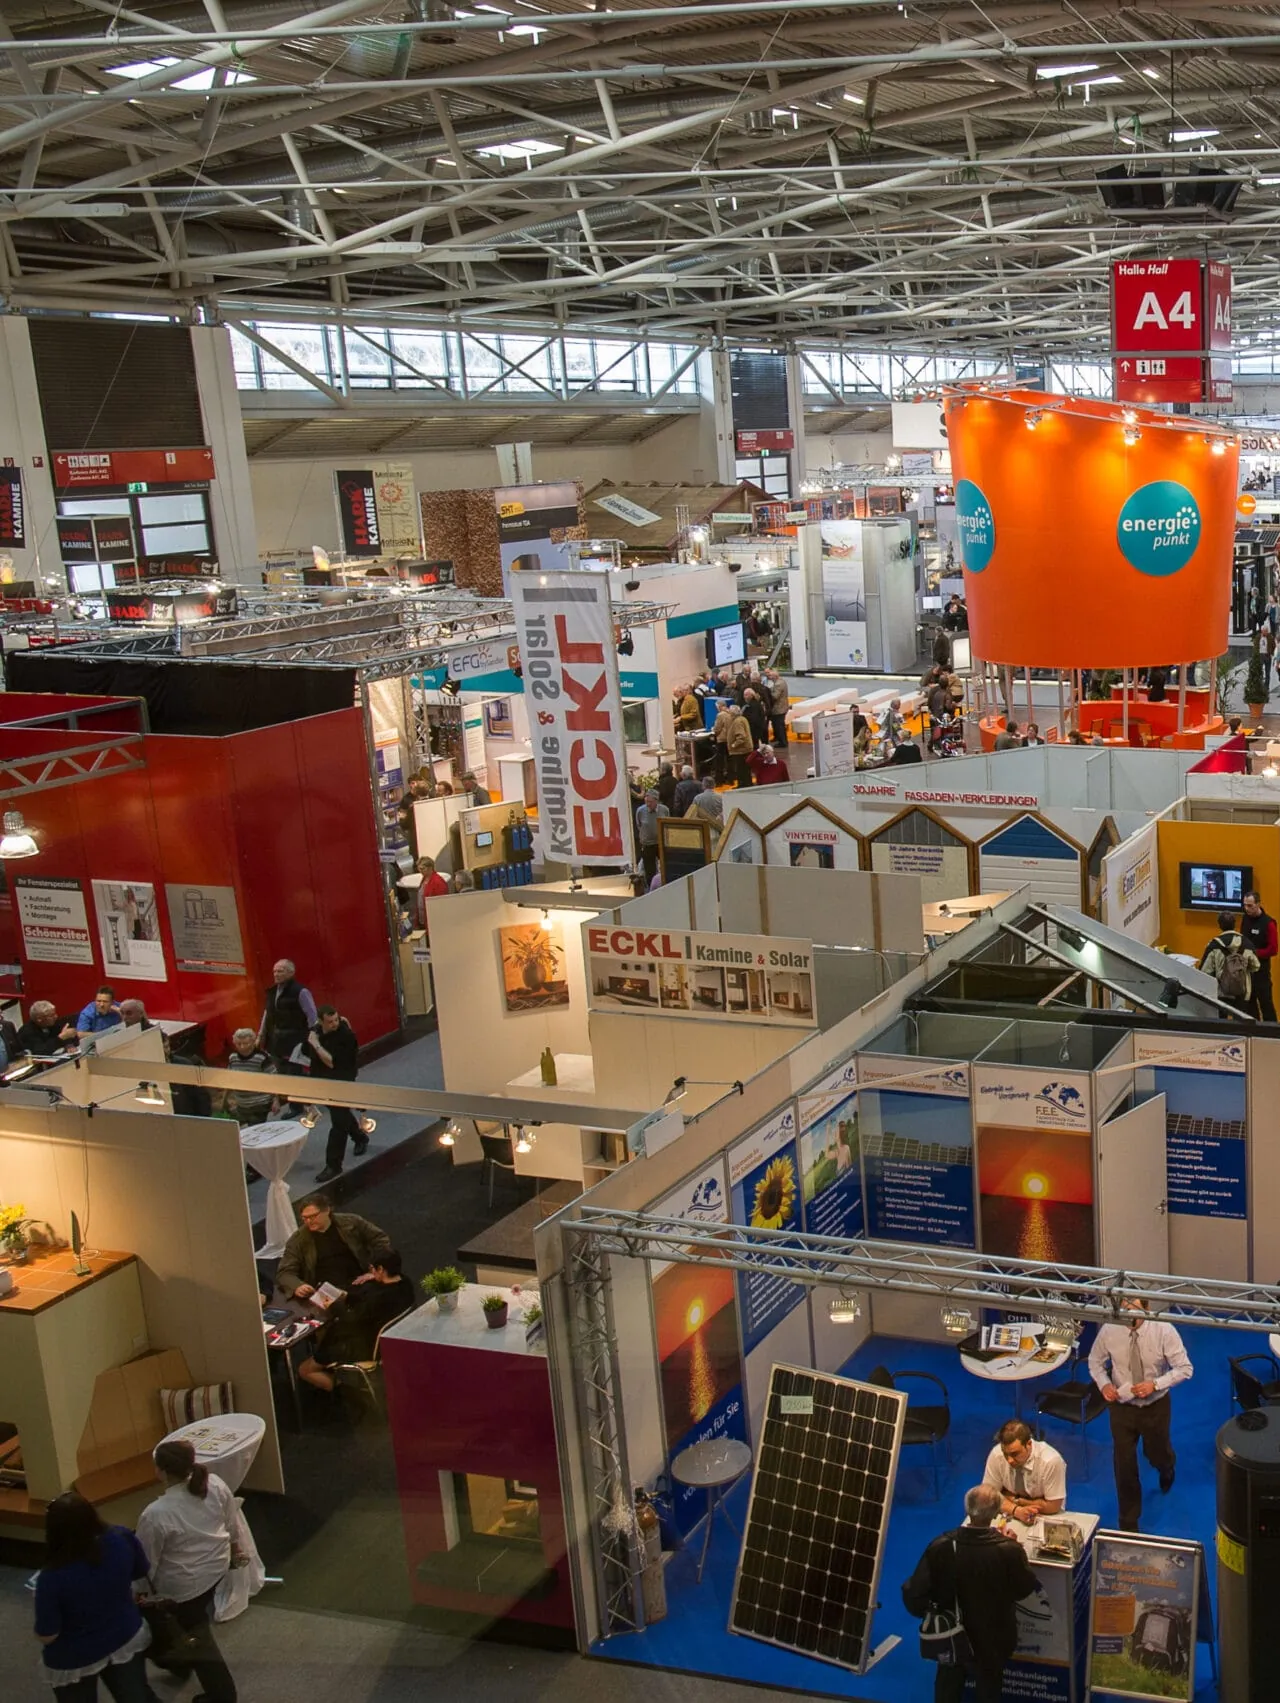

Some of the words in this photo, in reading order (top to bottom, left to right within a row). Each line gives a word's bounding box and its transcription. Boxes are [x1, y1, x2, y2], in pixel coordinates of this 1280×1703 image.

[1119, 264, 1145, 275] Halle
[1147, 264, 1169, 275] Hall
[1133, 291, 1195, 330] A4
[1214, 293, 1231, 331] A4
[13, 483, 24, 539] KAMINE
[364, 487, 380, 545] KAMINE
[1122, 515, 1191, 533] energie
[62, 541, 93, 549] KAMINE
[100, 539, 130, 549] KAMINE
[966, 532, 987, 546] punkt
[1153, 533, 1190, 550] punkt
[452, 652, 481, 673] EFG
[904, 790, 1038, 807] FASSADEN-VERKLEIDUNGEN
[784, 830, 838, 842] VINYTHERM
[25, 926, 88, 941] Schönreiter
[588, 928, 682, 959] ECKL
[695, 943, 753, 965] Kamine
[757, 953, 765, 965] &
[768, 949, 810, 969] Solar
[726, 1400, 740, 1420] Sie
